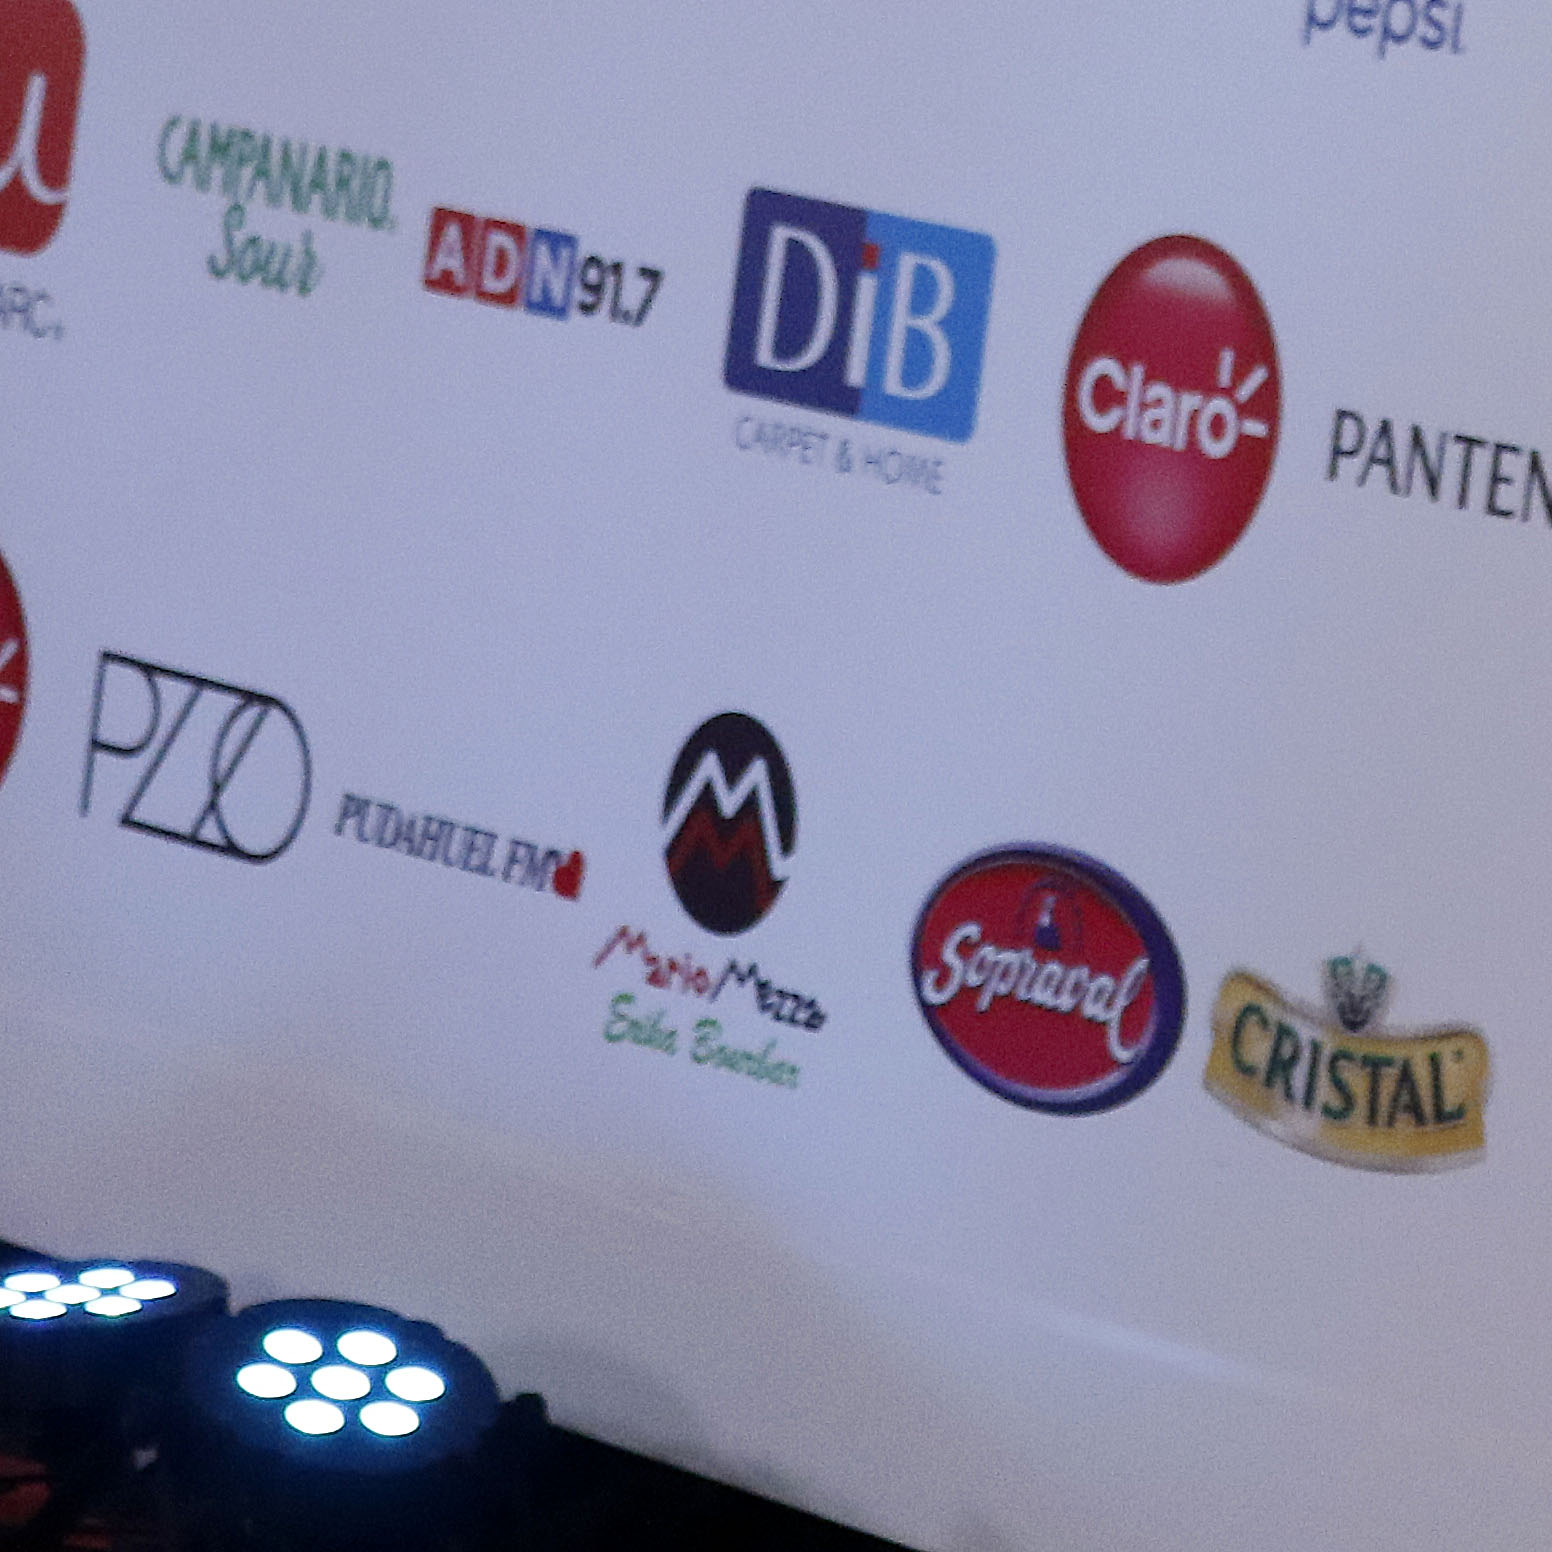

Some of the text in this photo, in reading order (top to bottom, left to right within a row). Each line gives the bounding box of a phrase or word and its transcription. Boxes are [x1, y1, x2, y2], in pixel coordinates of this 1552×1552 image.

[157, 112, 396, 231] CAMPANARIO
[1077, 356, 1239, 460] Claro
[334, 792, 562, 893] PUDAHUEL FM
[922, 920, 1152, 1067] Sopraval
[1229, 1004, 1467, 1128] CRISTAL
